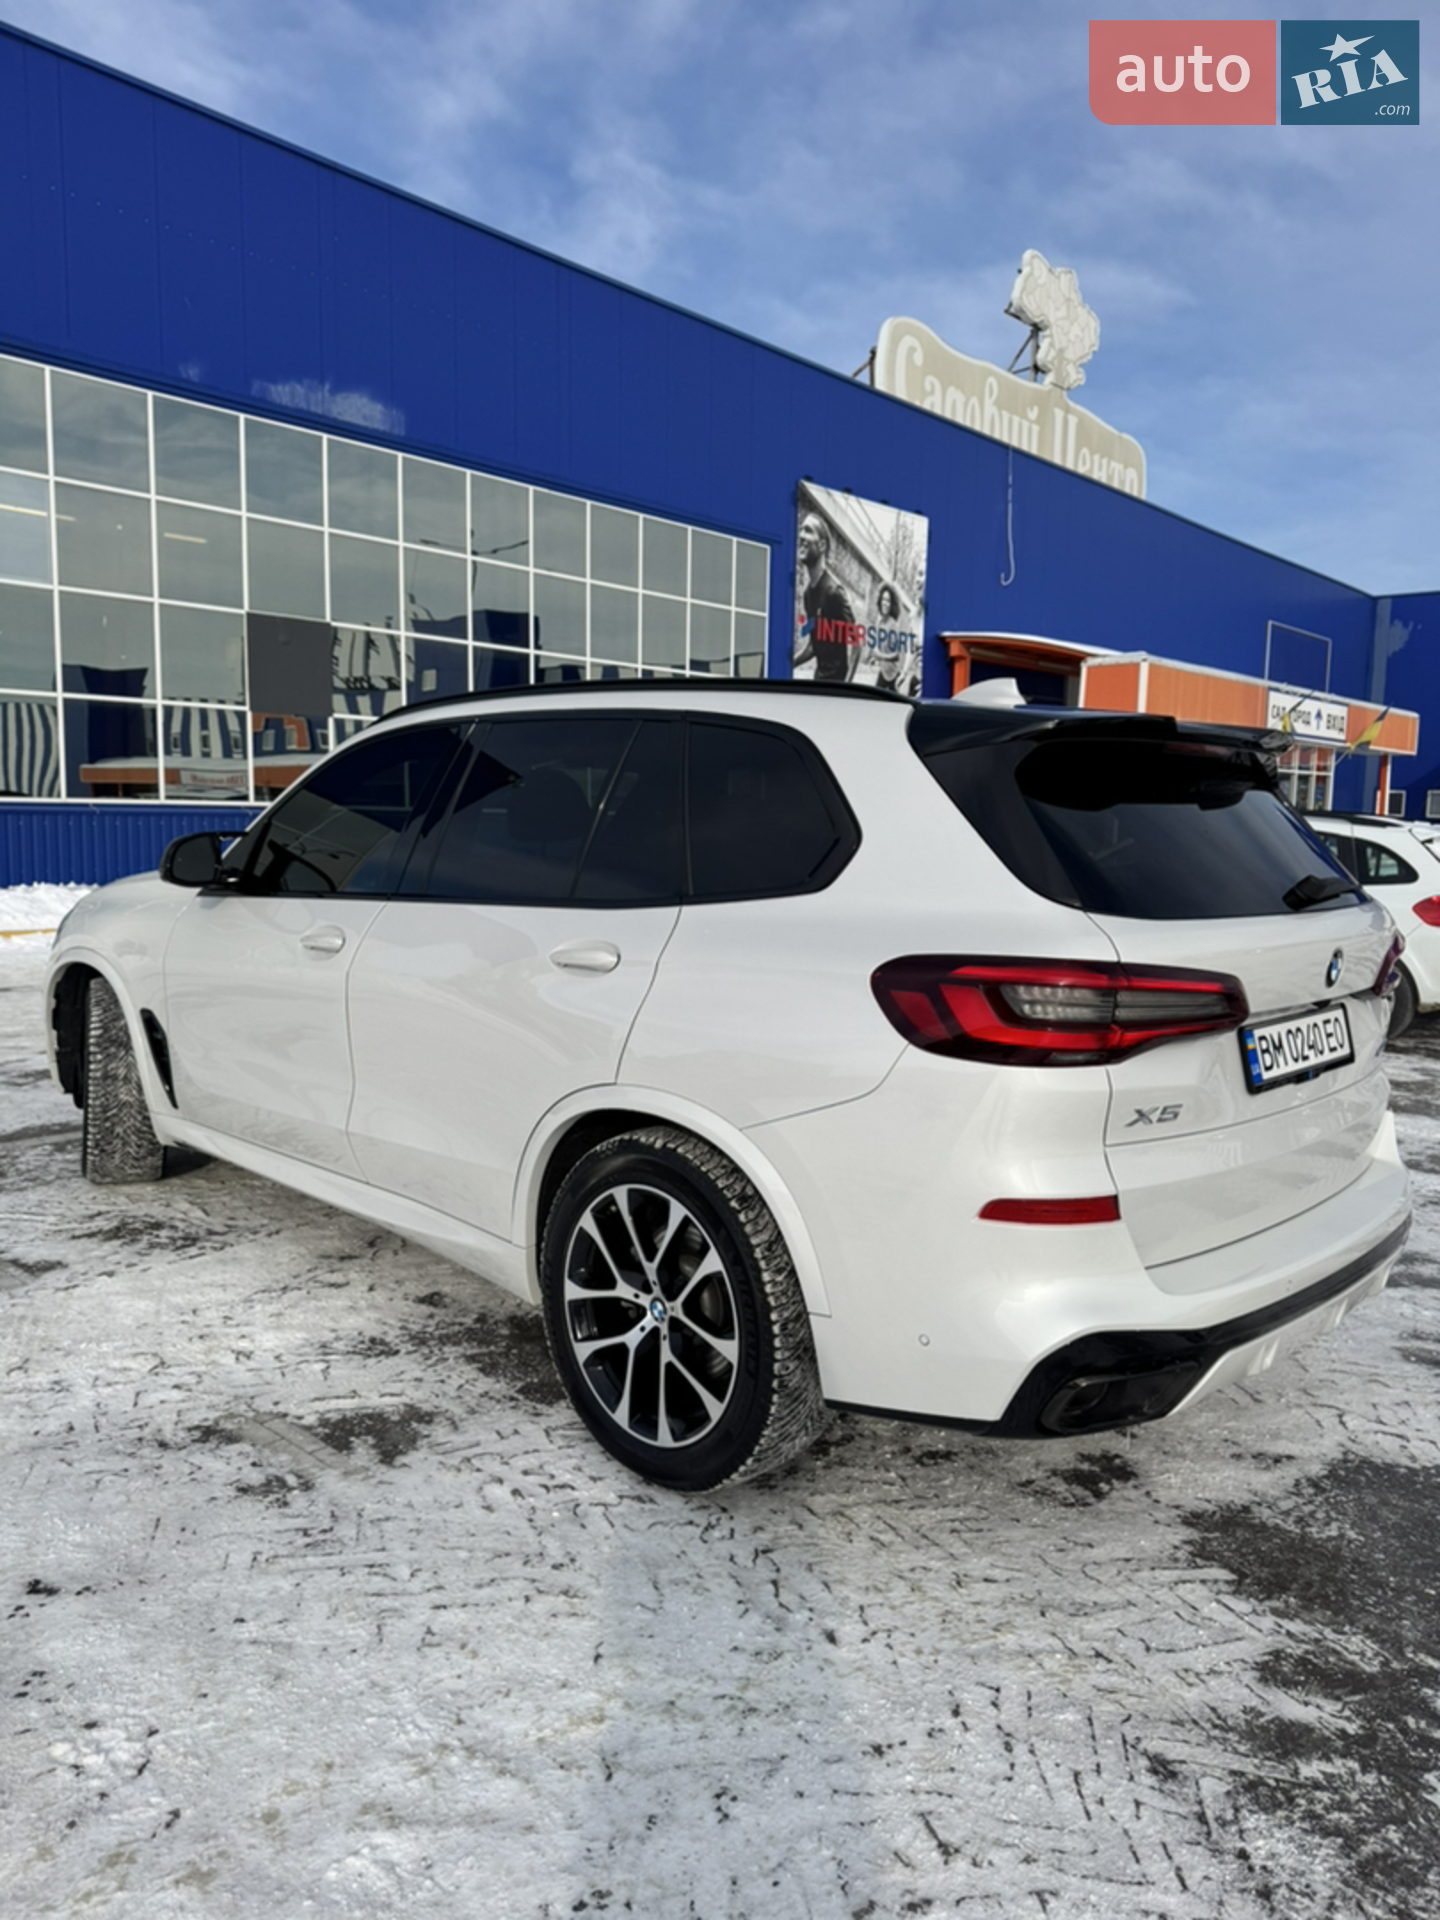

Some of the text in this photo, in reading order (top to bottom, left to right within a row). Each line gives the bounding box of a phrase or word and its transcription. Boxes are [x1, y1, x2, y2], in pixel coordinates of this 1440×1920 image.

[815, 616, 917, 654] INTERSPORT
[1258, 1031, 1288, 1072] BM
[1286, 1022, 1324, 1063] 0240
[1125, 1104, 1183, 1127] X5
